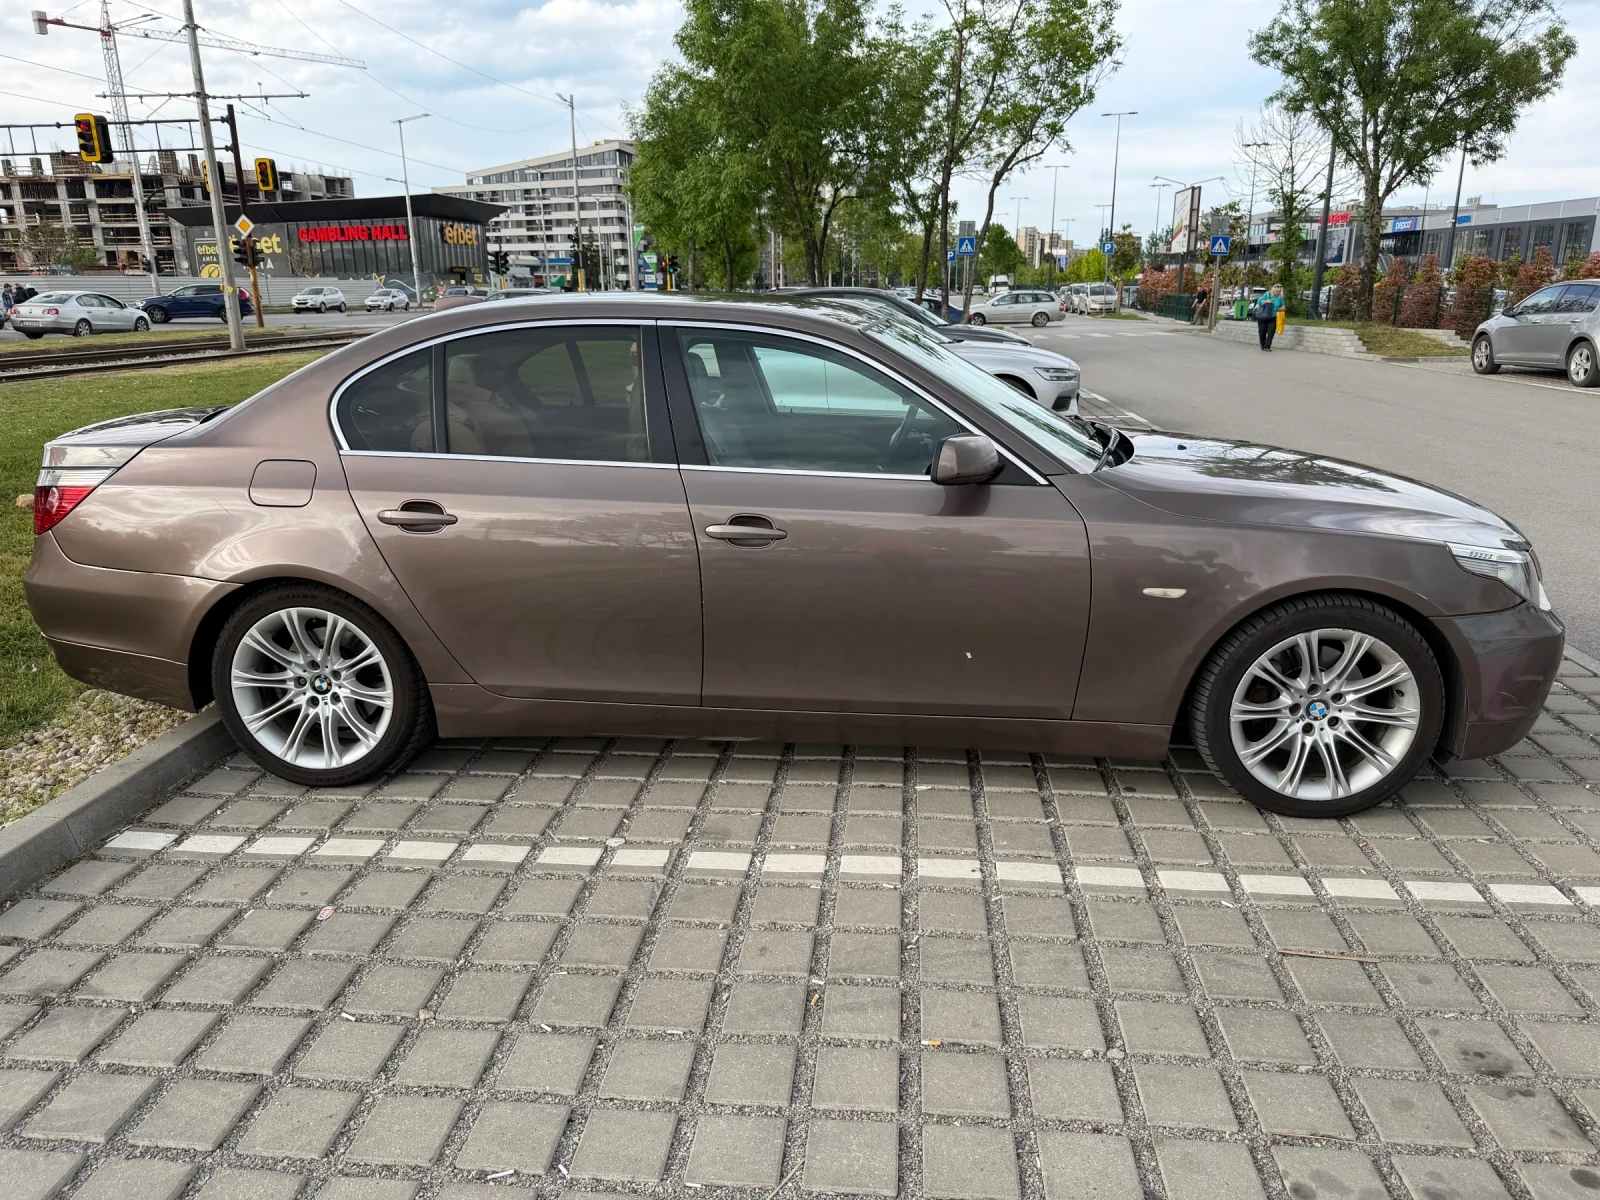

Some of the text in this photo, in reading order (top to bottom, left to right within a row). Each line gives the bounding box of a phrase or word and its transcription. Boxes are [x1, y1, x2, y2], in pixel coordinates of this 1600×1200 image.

[298, 223, 409, 243] GAMBLING HALL
[1395, 220, 1411, 231] pepco
[444, 222, 478, 245] efbet
[1104, 243, 1112, 253] P
